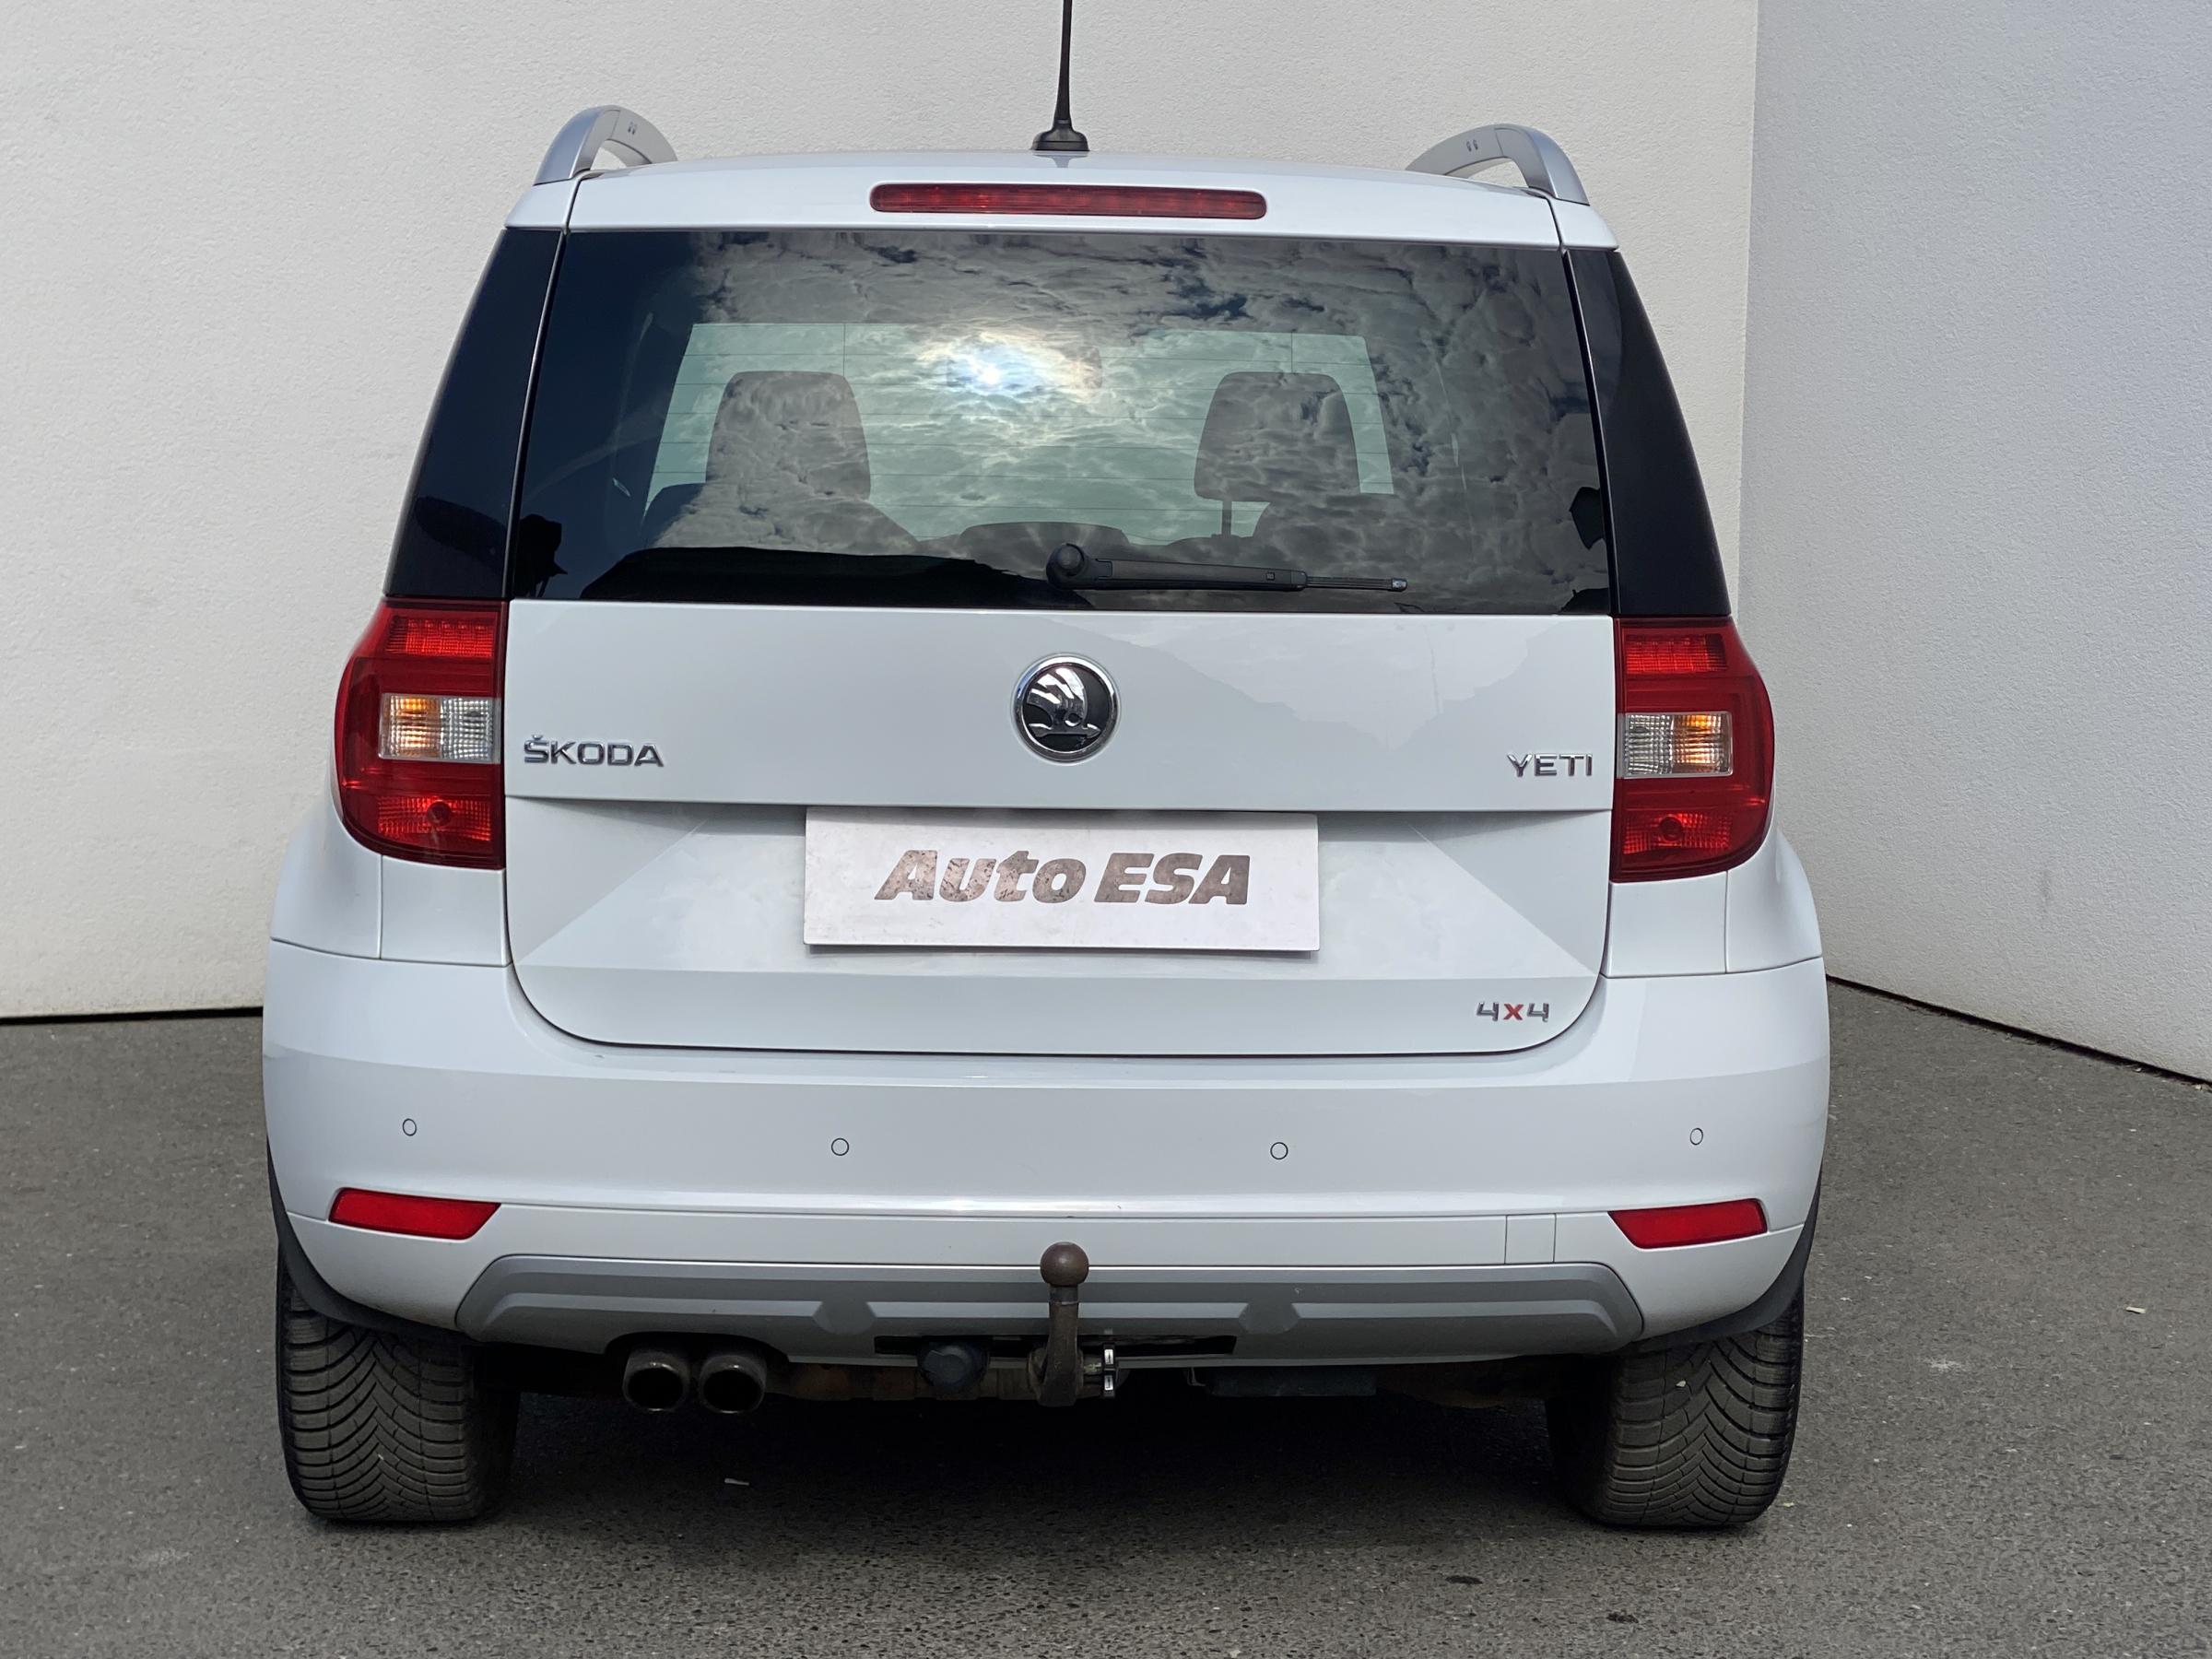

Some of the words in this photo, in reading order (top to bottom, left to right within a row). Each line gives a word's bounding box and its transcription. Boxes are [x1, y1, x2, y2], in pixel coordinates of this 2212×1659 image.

[524, 735, 665, 767] ŠKODA
[1506, 753, 1593, 777] YETI
[874, 849, 1087, 904] Auto
[1094, 853, 1251, 905] ESA
